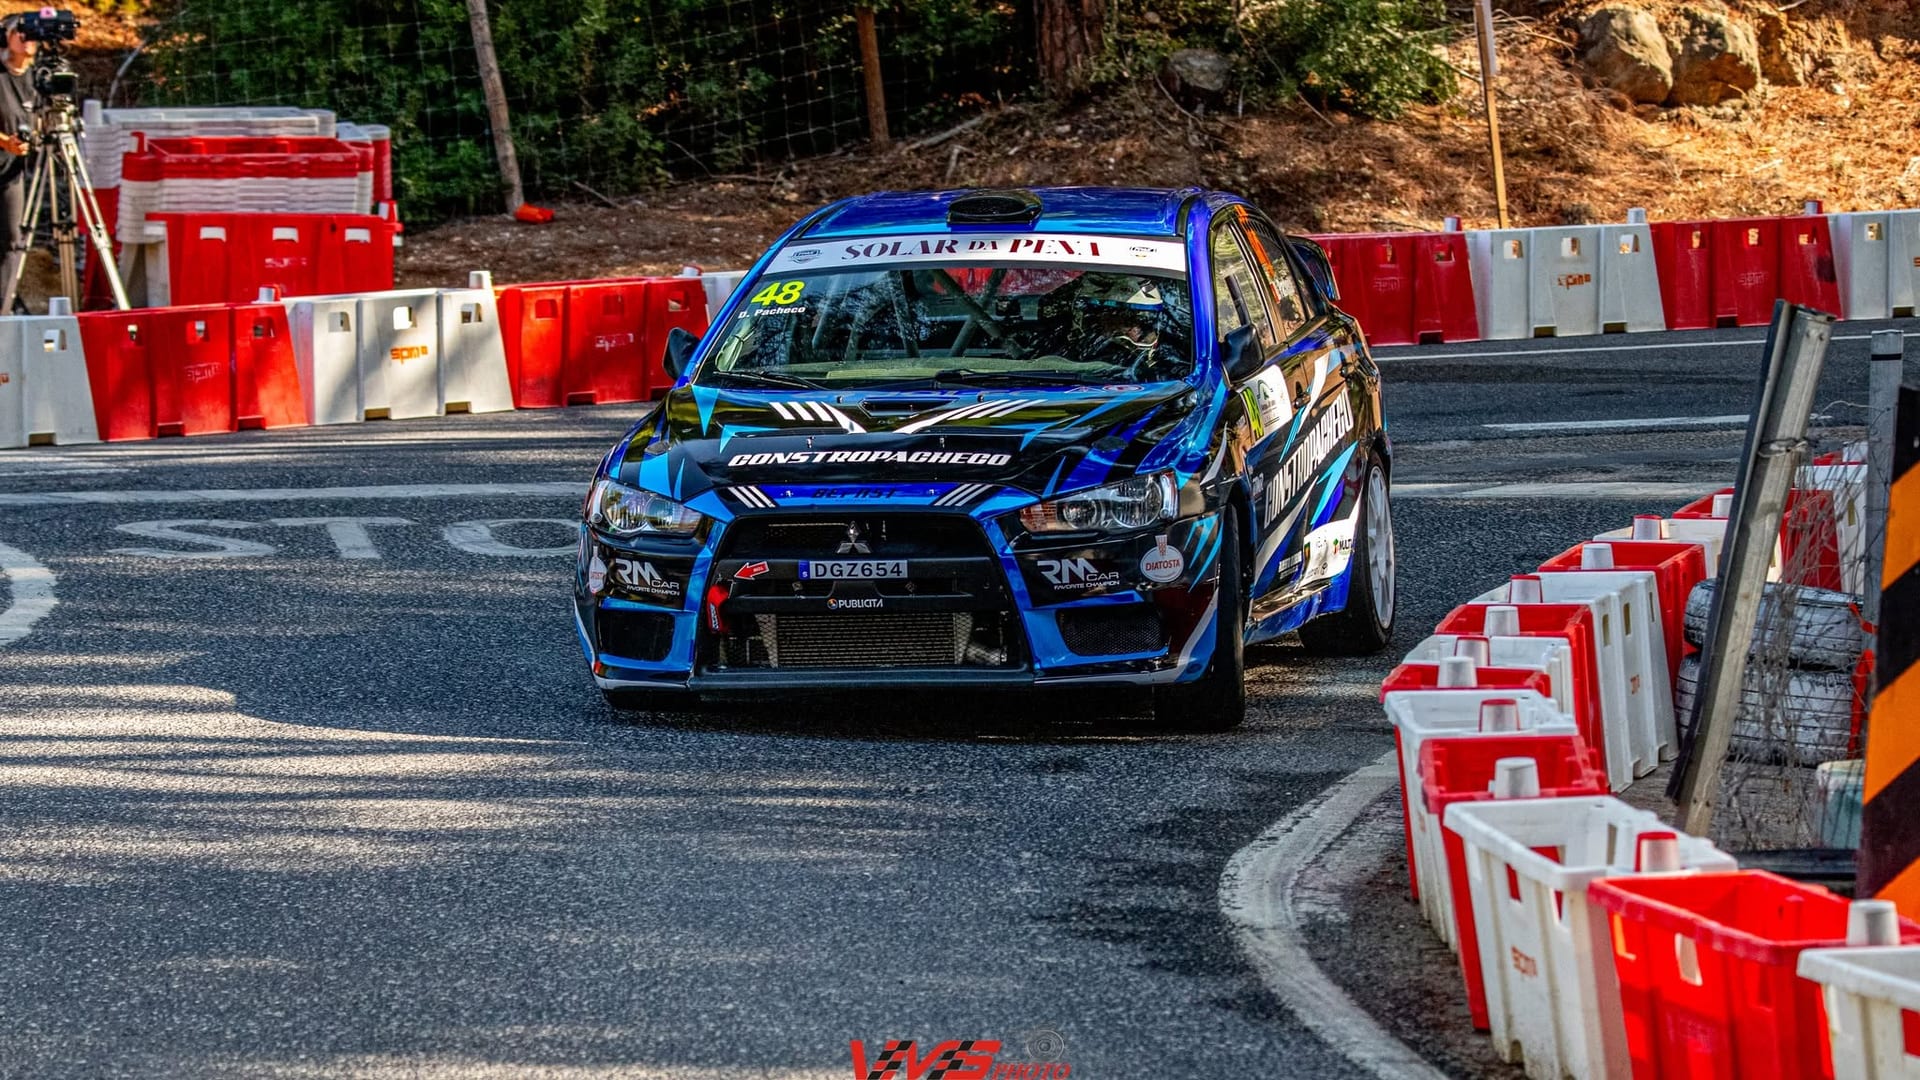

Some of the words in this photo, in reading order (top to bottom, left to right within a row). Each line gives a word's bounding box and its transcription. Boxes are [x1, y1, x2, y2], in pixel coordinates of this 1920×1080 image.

[841, 239, 960, 260] SOLAR
[750, 280, 806, 306] 48
[753, 306, 807, 317] Pacheco
[728, 450, 1012, 467] CONSTROPACHECO
[615, 558, 662, 586] RM
[814, 562, 903, 578] DGZ654
[1037, 557, 1099, 584] RM
[1145, 559, 1181, 572] DIATOSTA
[651, 579, 681, 590] CAR
[1086, 571, 1120, 582] CAR
